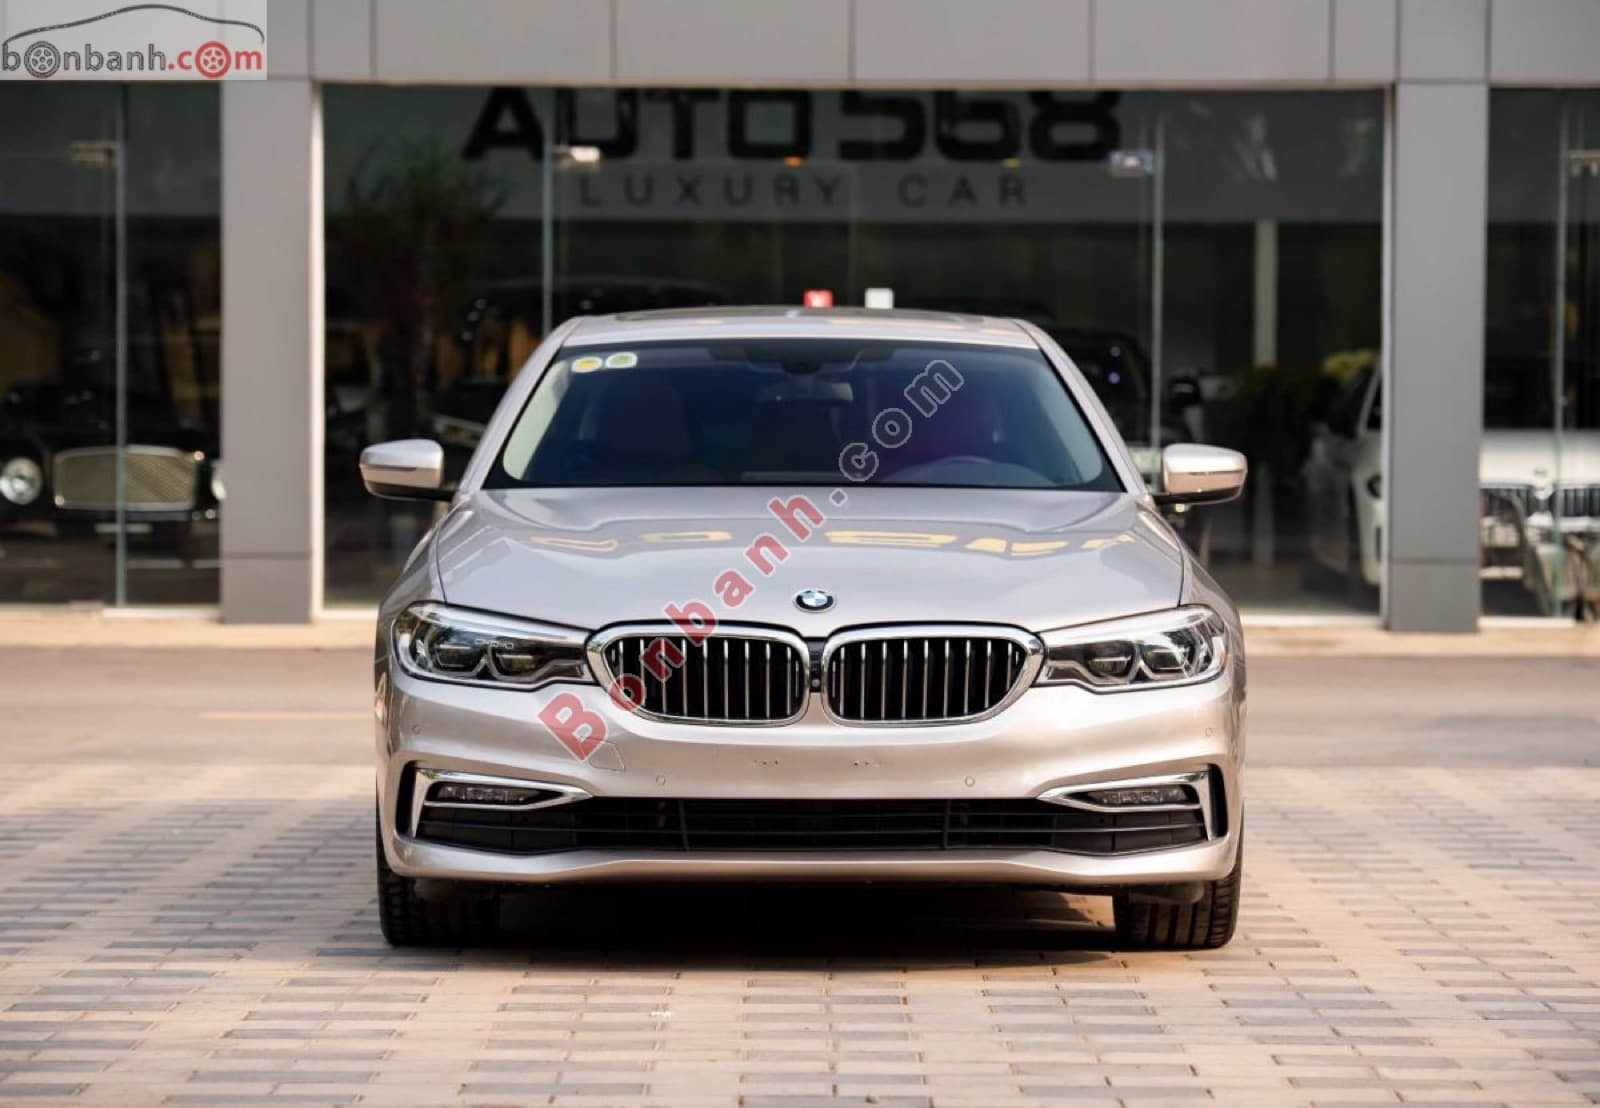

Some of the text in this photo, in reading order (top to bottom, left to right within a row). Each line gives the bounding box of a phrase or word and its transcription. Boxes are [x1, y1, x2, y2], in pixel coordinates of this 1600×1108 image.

[462, 88, 1122, 162] AUTO 568
[579, 174, 1028, 208] LUXURY CAR
